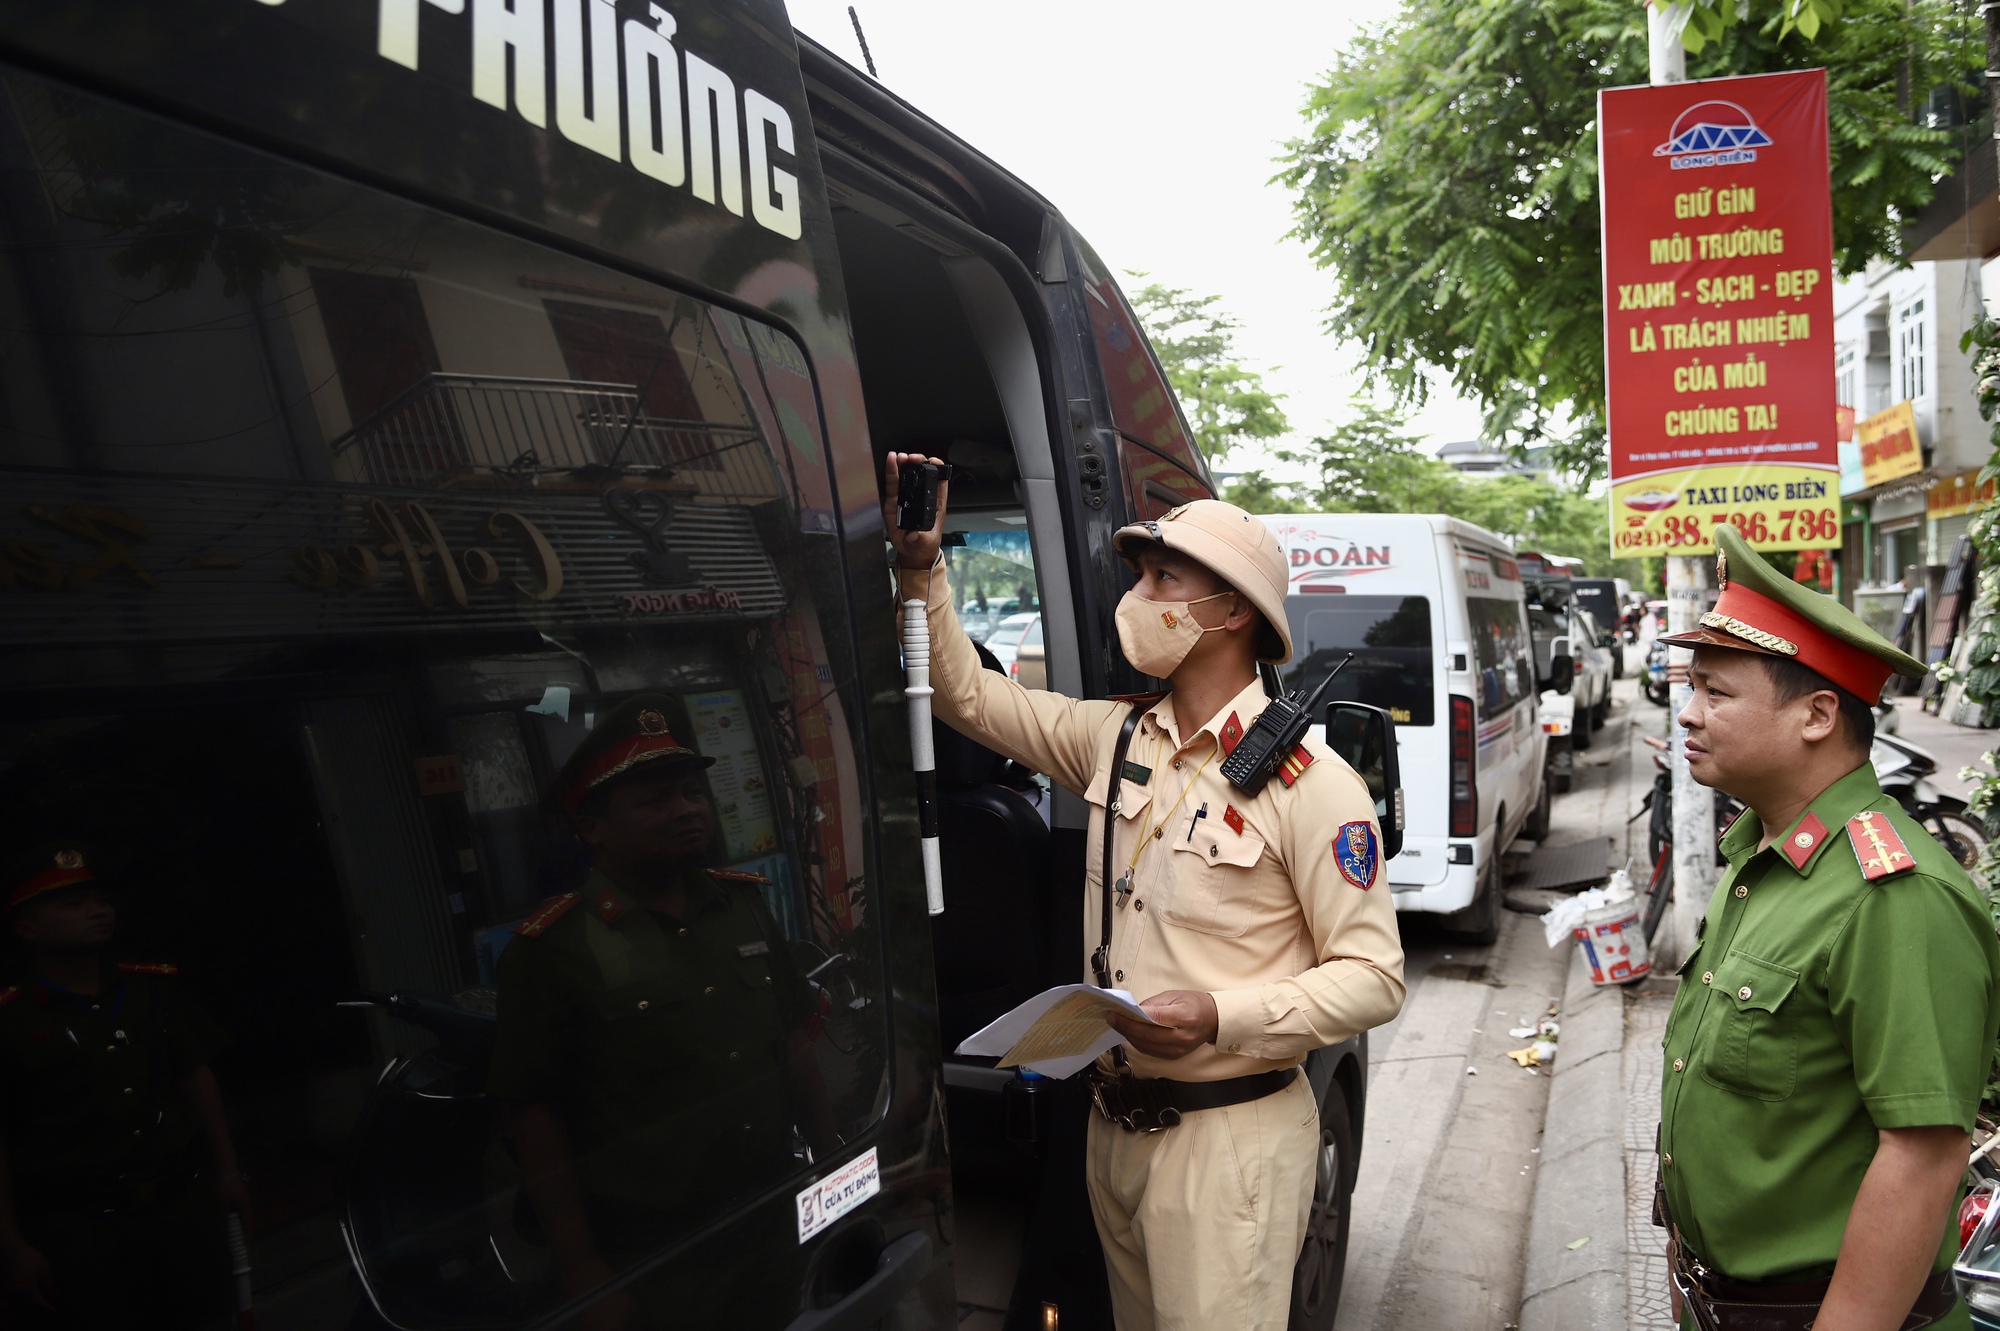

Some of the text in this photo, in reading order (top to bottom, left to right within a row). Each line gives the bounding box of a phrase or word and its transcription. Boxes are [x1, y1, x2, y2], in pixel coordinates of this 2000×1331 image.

[1671, 150, 1757, 169] LONG BIÊN
[1675, 183, 1756, 219] GIỮ GÌN
[1650, 225, 1784, 265] MÔI TRƯỜNG
[1618, 281, 1676, 310] XANH
[1696, 275, 1755, 308] SẠCH
[1775, 269, 1820, 301] ĐẸP
[1630, 310, 1810, 353] LÀ TRÁCH NHIỆM
[1674, 352, 1767, 393] CỦA MỖI
[1665, 403, 1778, 437] CHÚNG TA!
[1686, 487, 1727, 505] TAXI
[1734, 483, 1779, 502] LONG
[1785, 476, 1826, 500] BIÊN
[1290, 541, 1391, 567] ĐOÀN
[1344, 855, 1373, 868] CSGT
[856, 1168, 877, 1189] ĐỘNG
